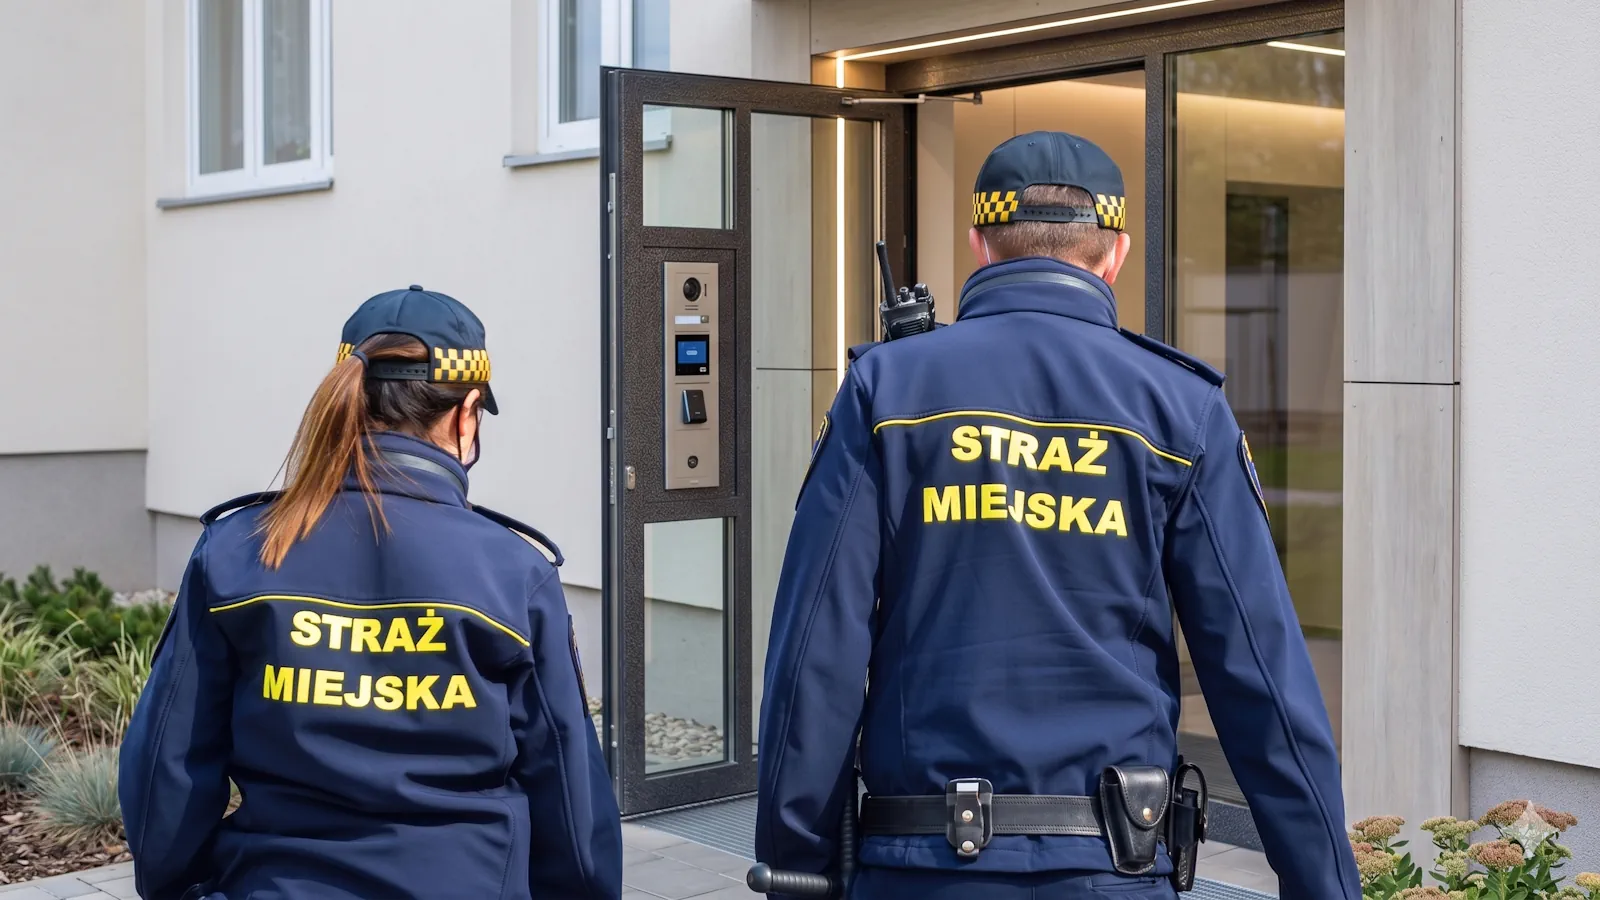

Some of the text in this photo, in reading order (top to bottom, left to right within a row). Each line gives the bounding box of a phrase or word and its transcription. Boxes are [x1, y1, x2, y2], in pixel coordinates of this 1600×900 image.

[951, 425, 1108, 475] STRAŻ
[923, 484, 1128, 536] MIEJSKA
[290, 609, 447, 653] STRAŻ
[263, 665, 477, 711] MIEJSKA
